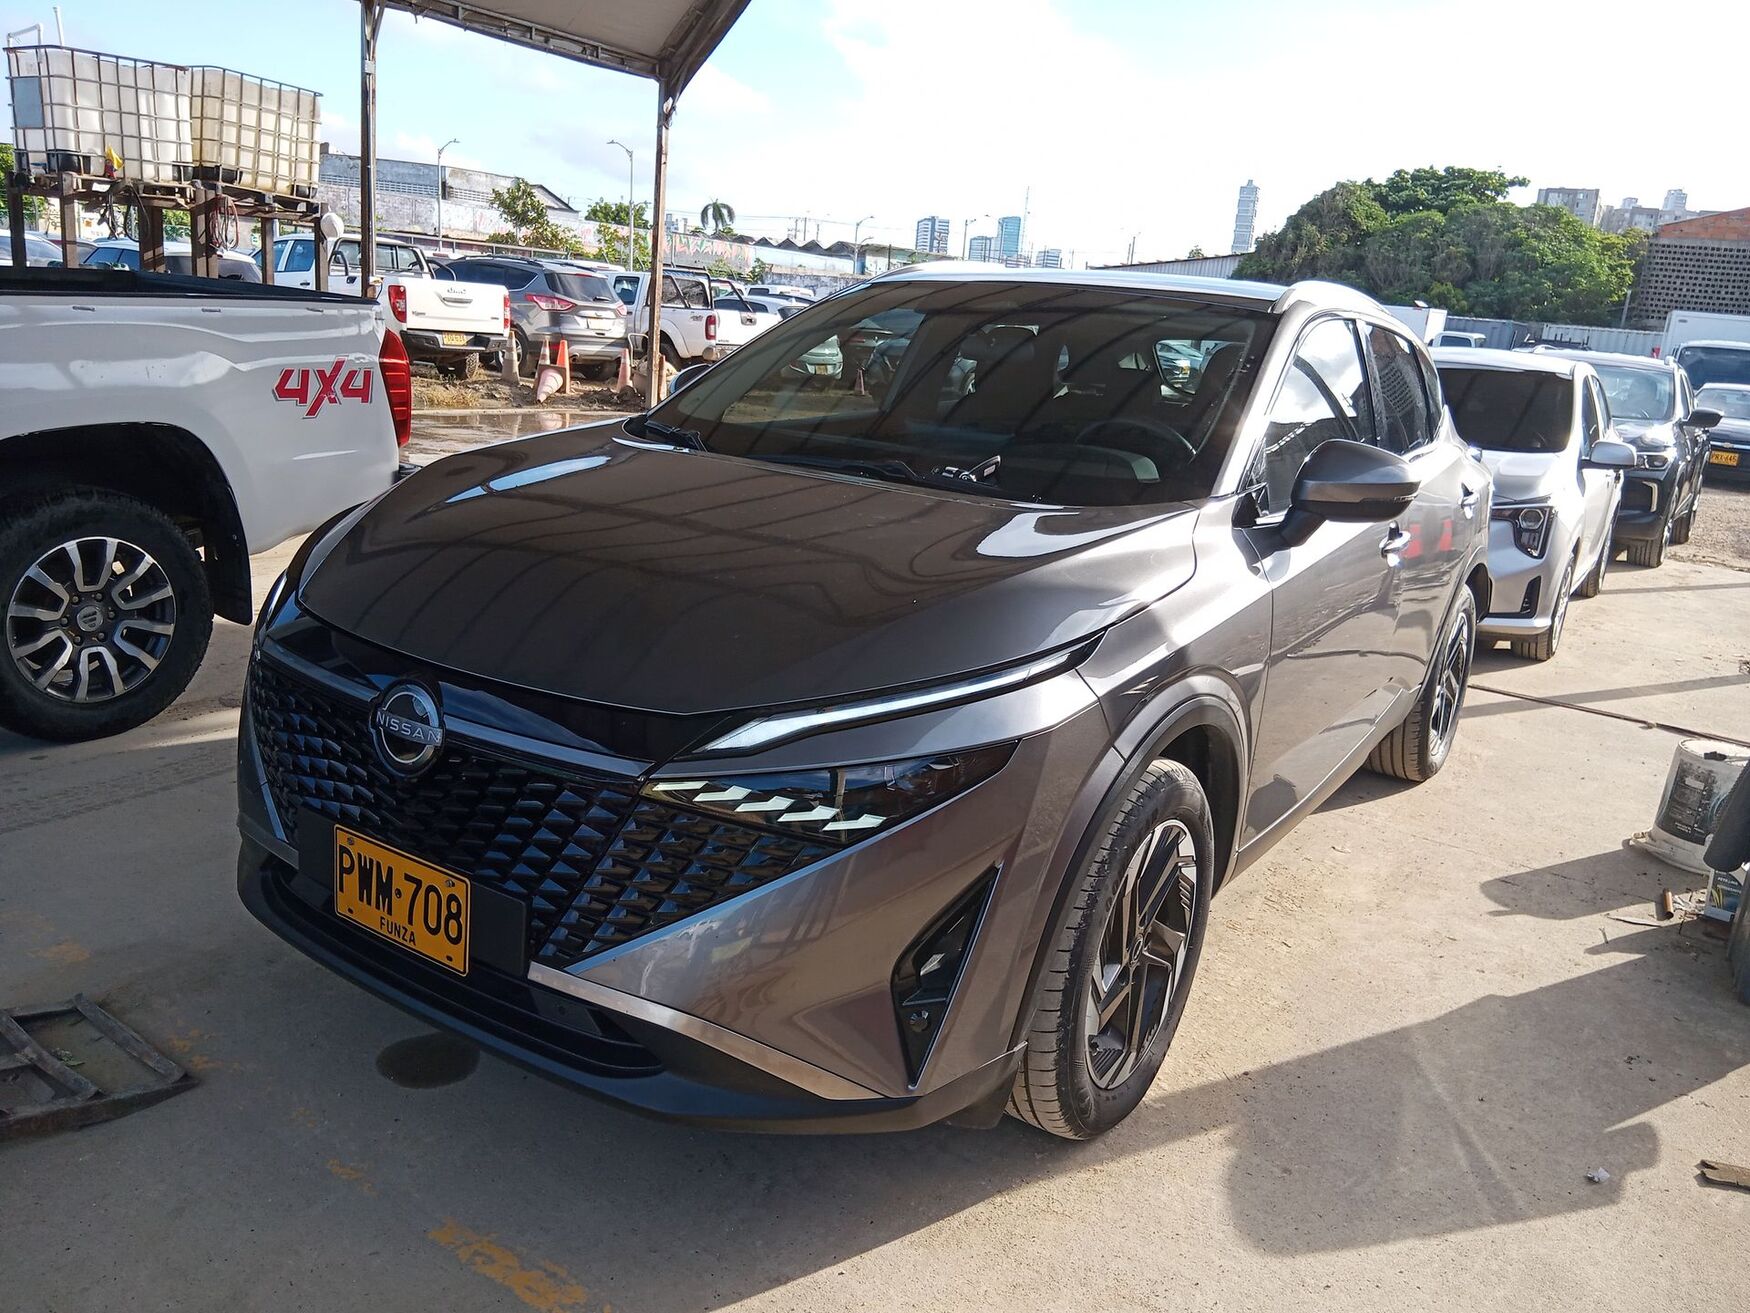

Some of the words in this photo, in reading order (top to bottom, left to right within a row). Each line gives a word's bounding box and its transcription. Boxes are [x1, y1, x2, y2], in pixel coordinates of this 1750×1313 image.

[273, 356, 373, 419] 4X4
[376, 710, 441, 742] NISSAN
[380, 916, 416, 946] FUNZA
